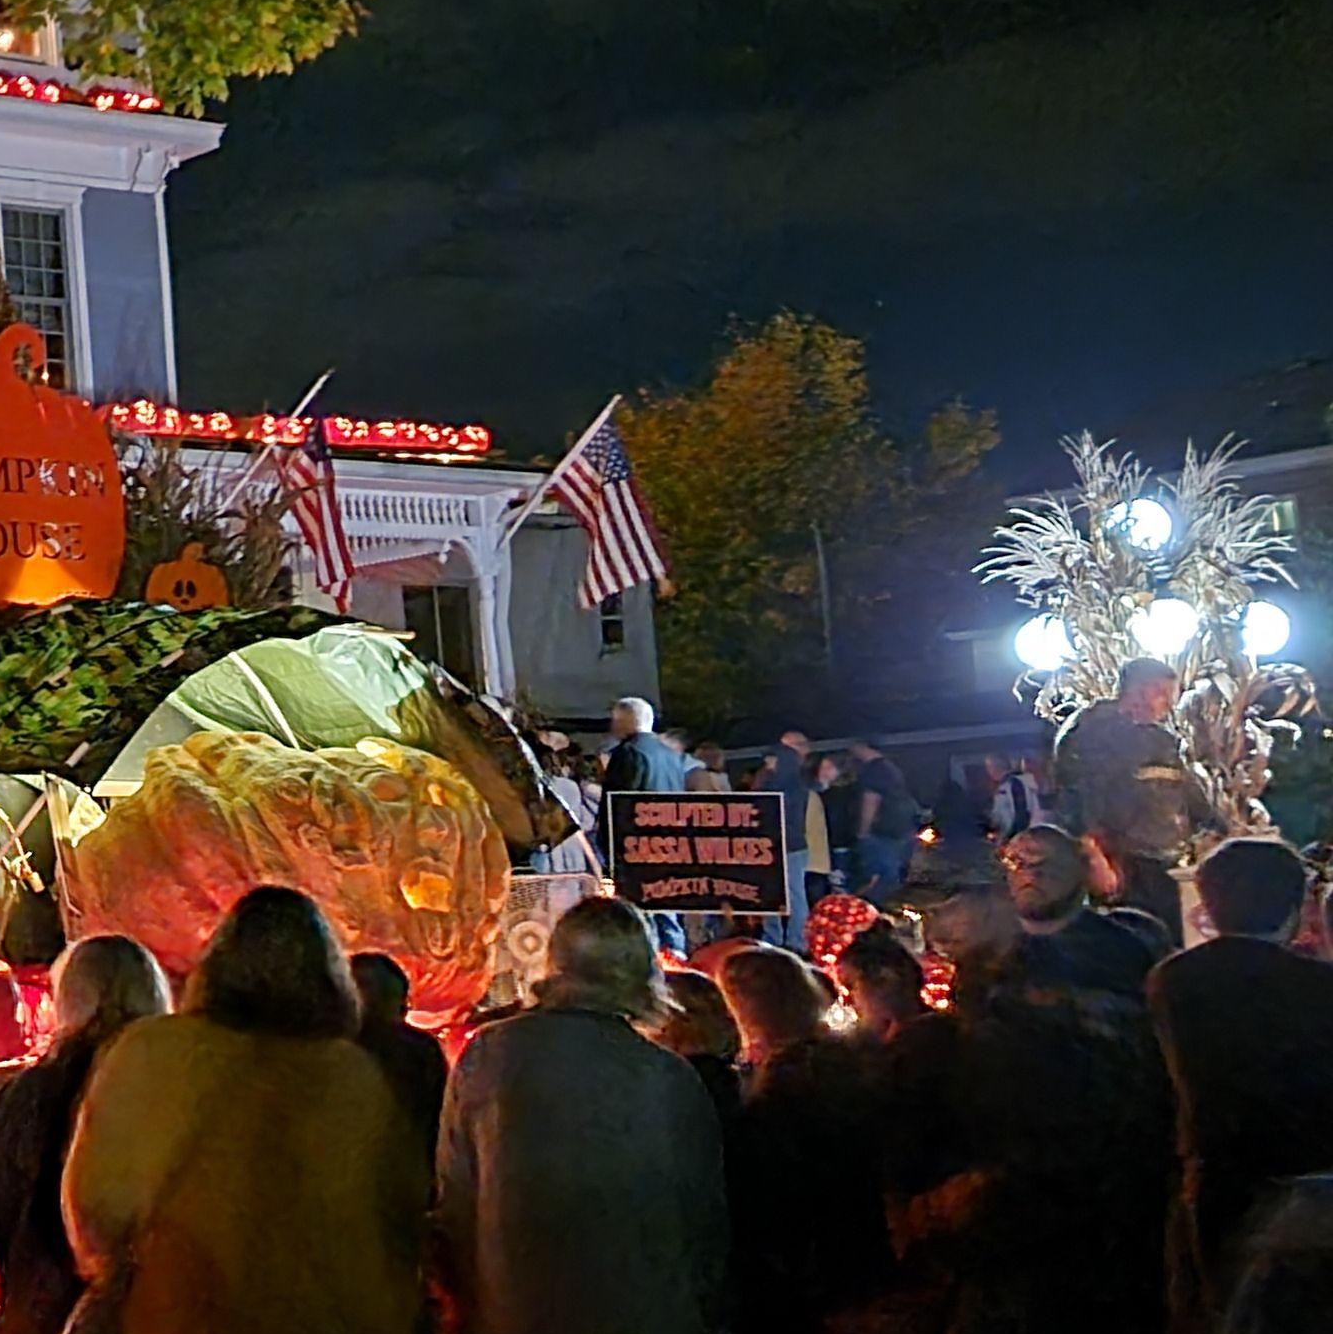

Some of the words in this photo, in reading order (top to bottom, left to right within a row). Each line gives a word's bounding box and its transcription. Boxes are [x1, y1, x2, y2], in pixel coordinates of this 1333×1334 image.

[635, 802, 724, 826] SCULPTED
[727, 802, 759, 827] BY:
[624, 835, 693, 864] SASSA
[694, 836, 773, 865] WILKES
[641, 876, 709, 902] PUMPKIN
